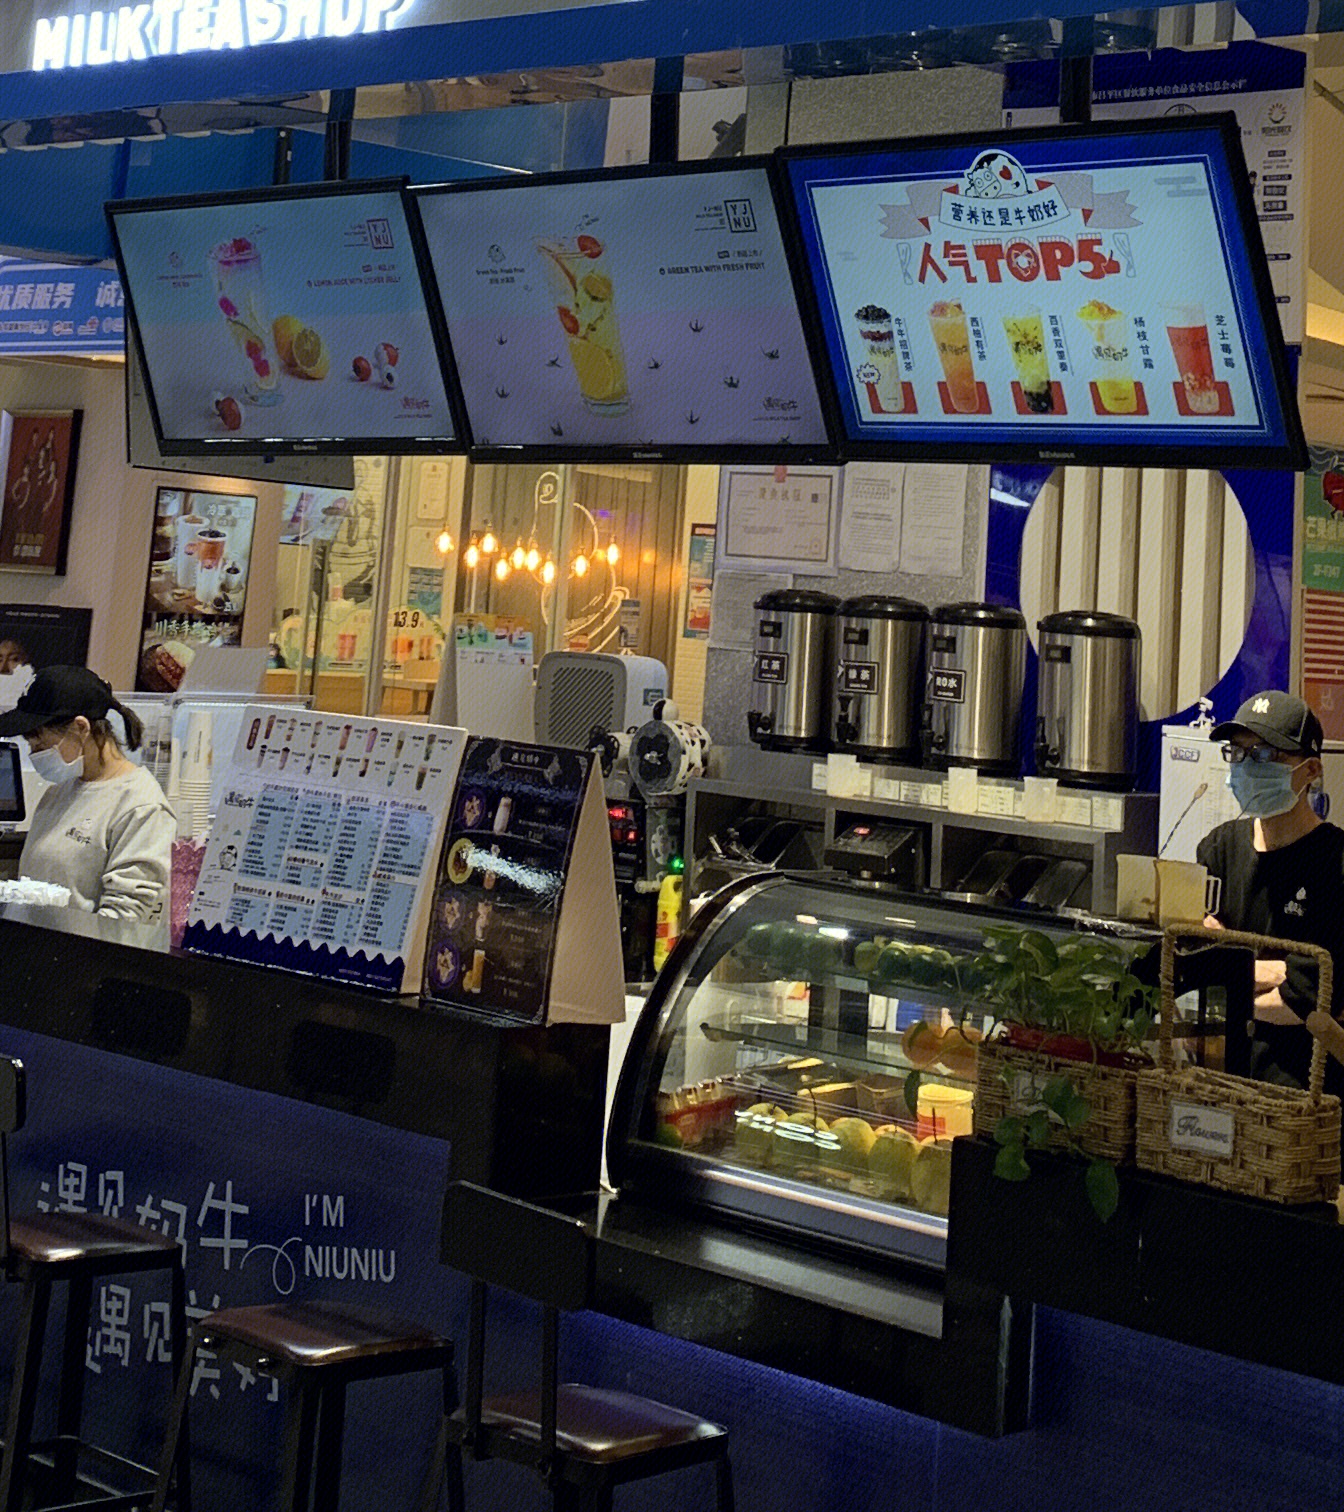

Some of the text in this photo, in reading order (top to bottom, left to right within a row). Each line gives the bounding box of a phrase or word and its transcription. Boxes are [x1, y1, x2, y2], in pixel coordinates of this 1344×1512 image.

[951, 200, 1058, 226] 营养还是牛奶好
[690, 265, 703, 273] TEA
[704, 264, 721, 272] WITH
[1048, 315, 1069, 373] 百香双重奏
[1214, 314, 1236, 369] 芝士莓莓
[393, 612, 419, 629] 13.9
[1176, 1115, 1229, 1144] Flowers
[304, 1194, 345, 1228] I'M
[304, 1244, 397, 1283] NIUNIU
